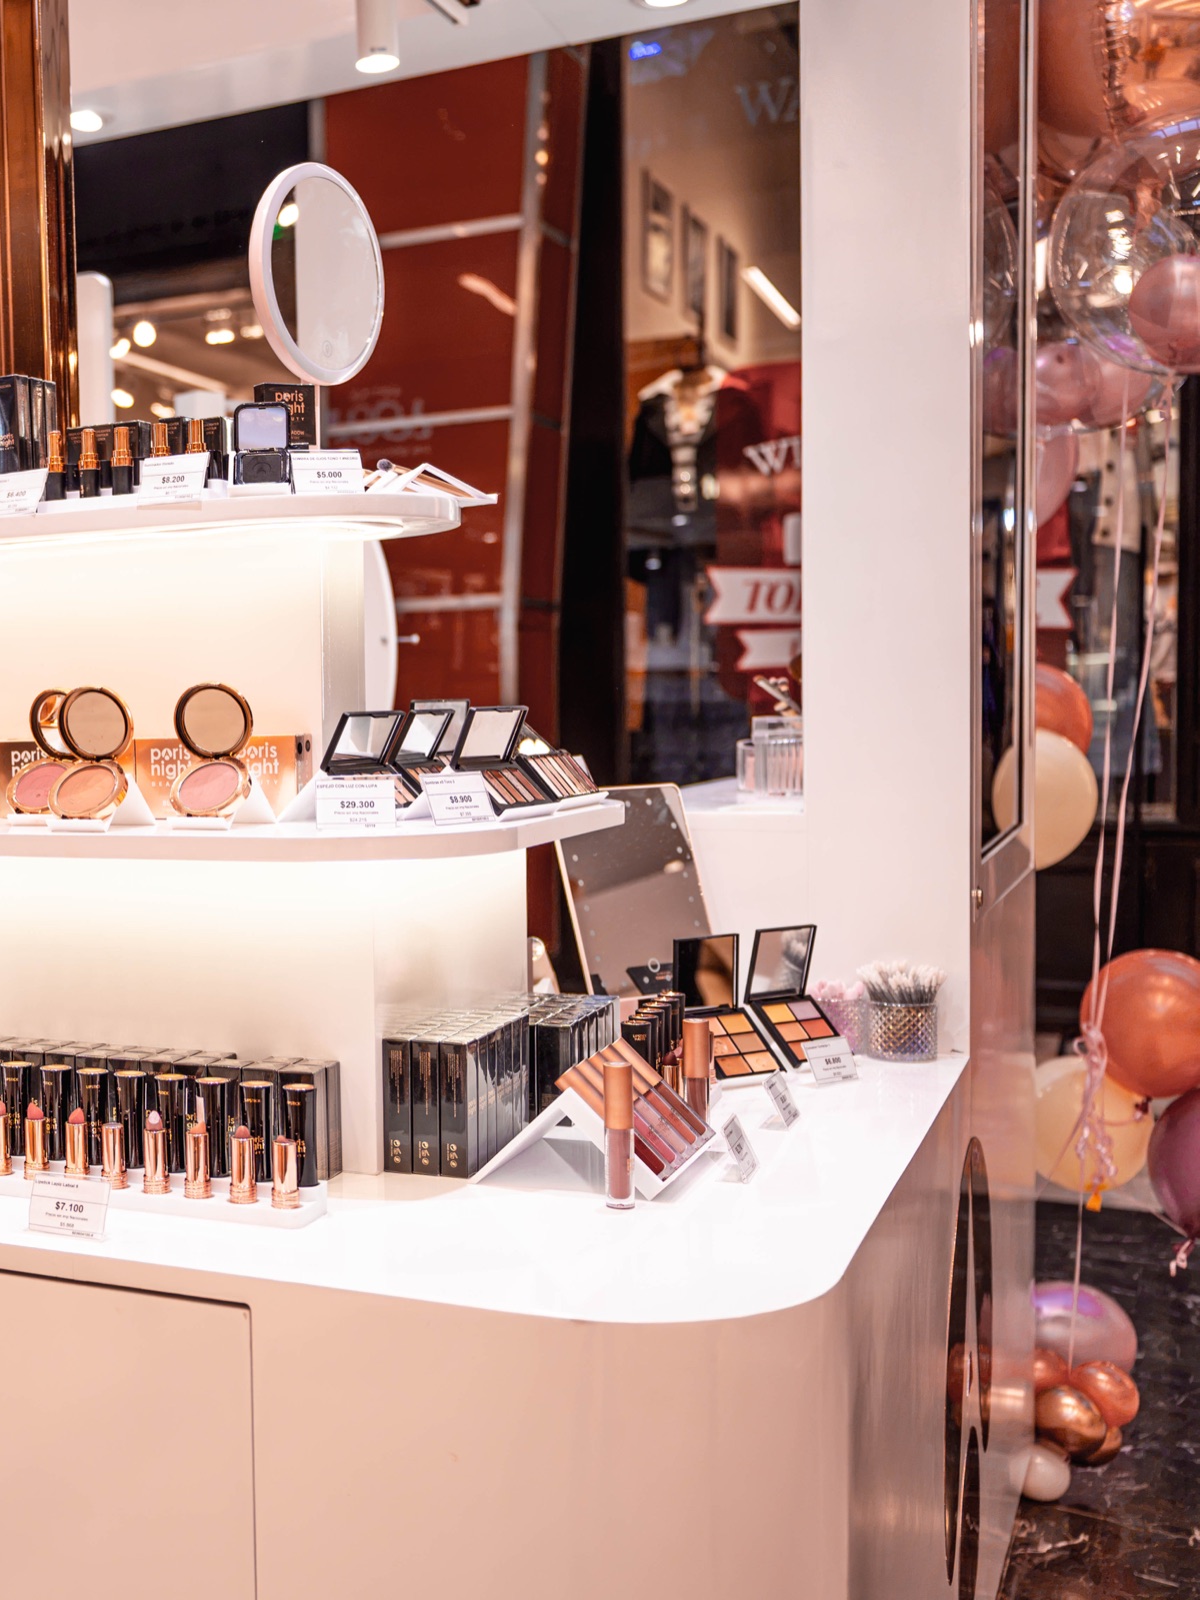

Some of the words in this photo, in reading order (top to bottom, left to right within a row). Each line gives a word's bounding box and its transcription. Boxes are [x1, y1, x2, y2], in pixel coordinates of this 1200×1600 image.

[161, 475, 185, 484] $8.200
[316, 471, 342, 479] $5.000
[340, 800, 375, 809] $29.300
[55, 1201, 84, 1213] $7.100
